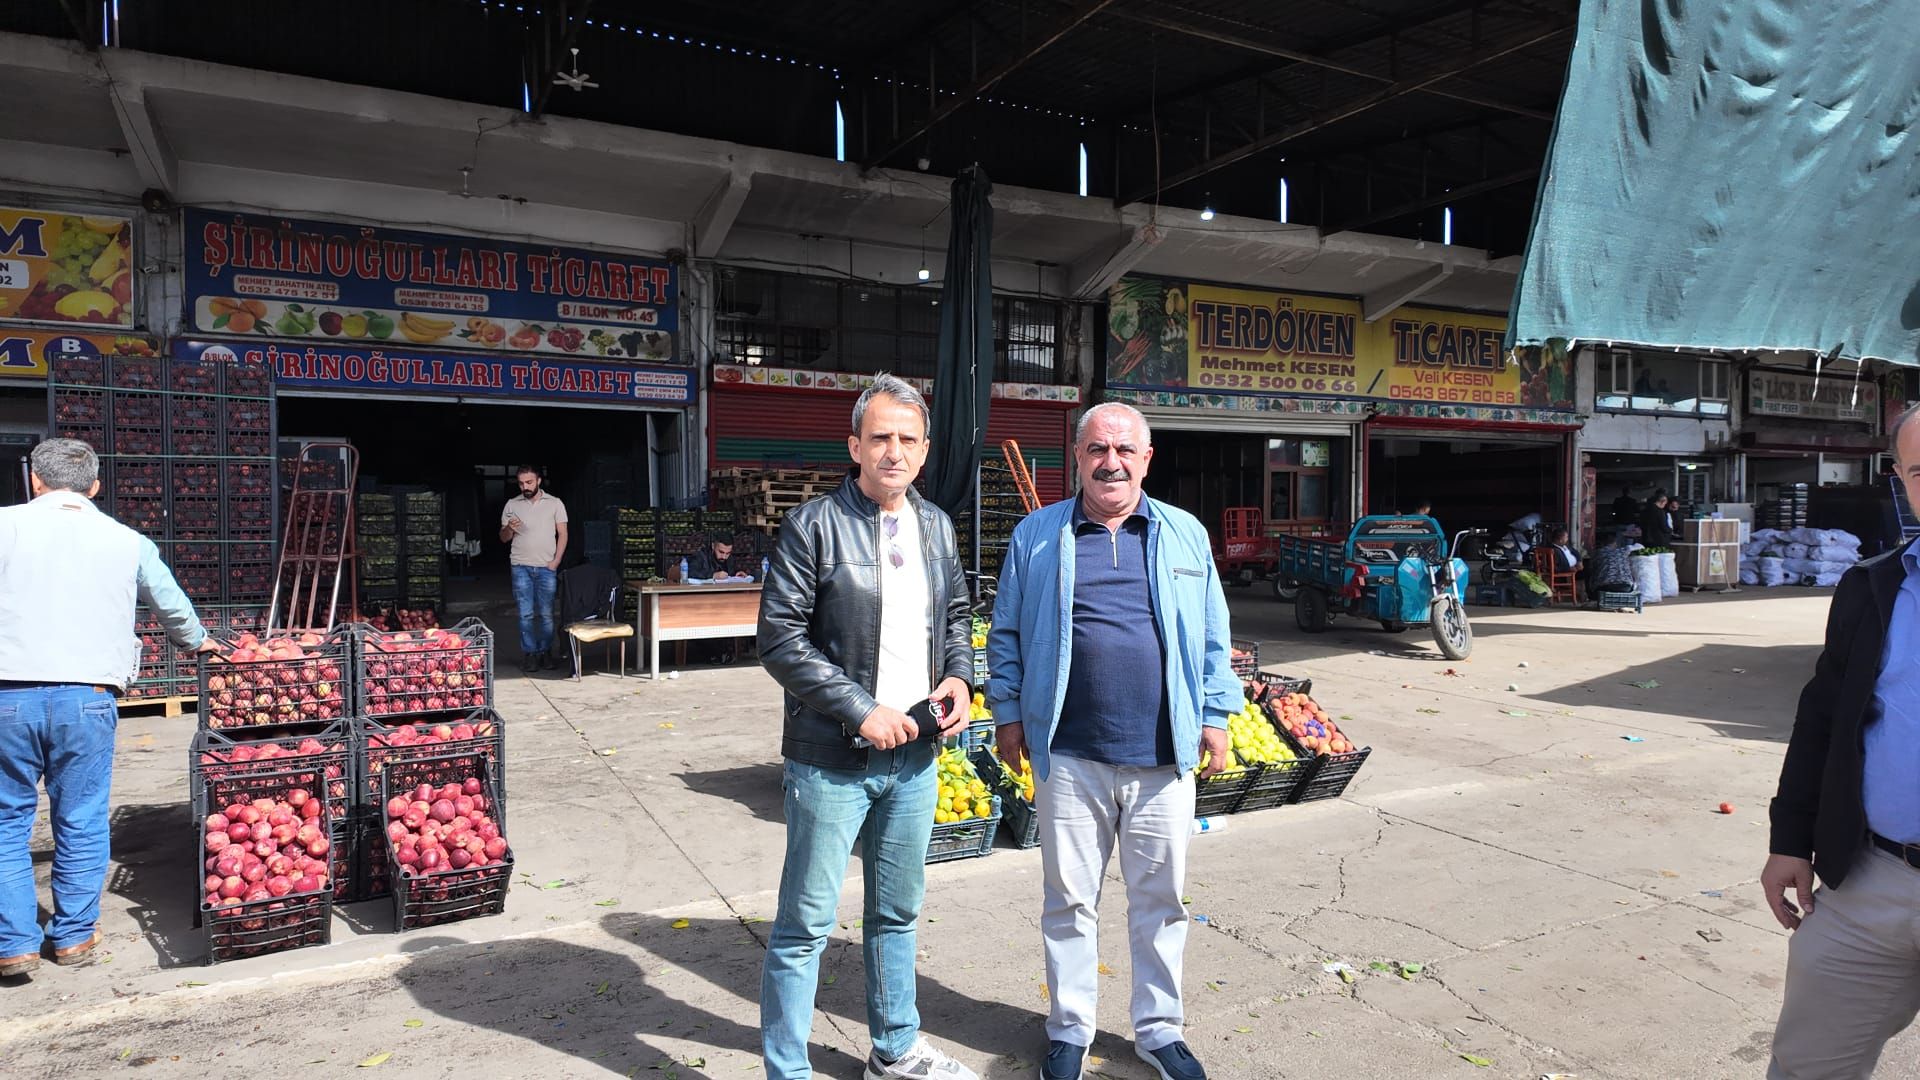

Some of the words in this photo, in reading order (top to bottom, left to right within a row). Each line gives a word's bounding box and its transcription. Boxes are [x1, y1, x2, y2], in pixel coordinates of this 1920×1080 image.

[203, 213, 519, 291] ŞİRİNOĞULLARI
[527, 247, 670, 305] TİCARET
[238, 276, 272, 286] MEHMET
[274, 279, 315, 290] BAHATTİN
[316, 283, 336, 293] ATEŞ
[239, 285, 271, 294] 0532
[303, 289, 318, 298] 12
[399, 289, 437, 298] MEHMET
[439, 291, 461, 300] EMİN
[463, 295, 484, 303] ATEŞ
[562, 303, 571, 315] B
[579, 304, 609, 319] BLOK
[616, 307, 638, 321] NO:
[639, 309, 654, 323] 43
[1194, 297, 1357, 358] TERDÖKEN
[1200, 355, 1285, 373] Mehmet
[1290, 360, 1356, 378] KESEN
[510, 360, 632, 394] TİCARET
[1199, 372, 1252, 388] 0532
[1259, 375, 1297, 390] 500
[1301, 377, 1326, 391] 06
[1330, 379, 1356, 393] 66
[1413, 369, 1439, 384] Veli
[1442, 371, 1494, 387] KESEN
[1389, 385, 1433, 399] 0543
[1437, 388, 1469, 401] 867
[1472, 390, 1493, 402] 80
[1495, 392, 1515, 403] 58
